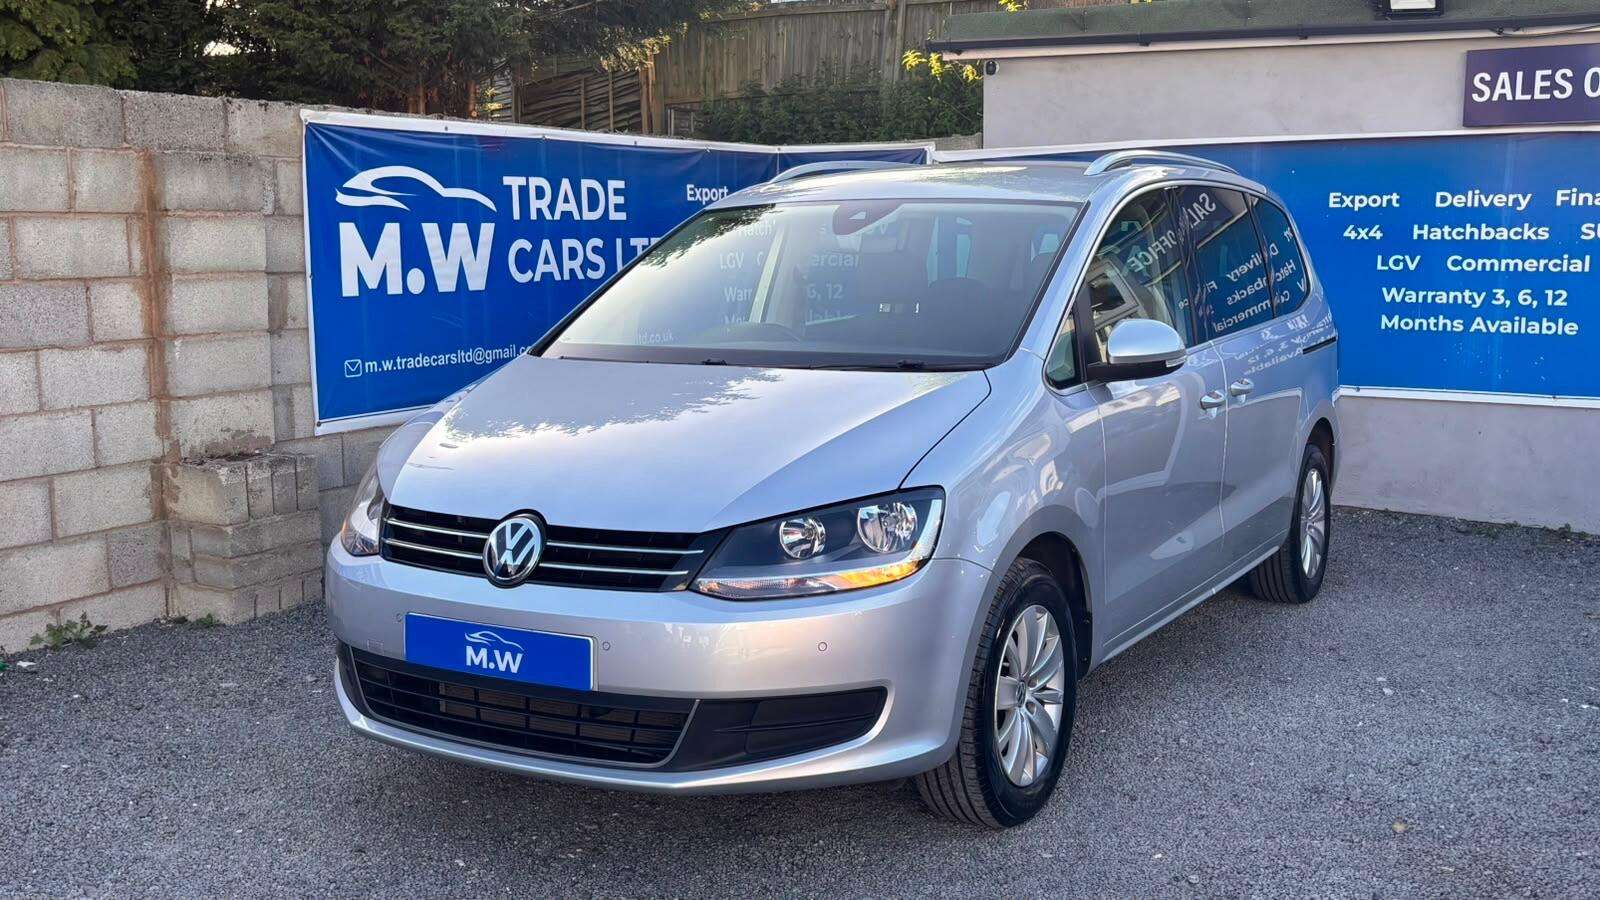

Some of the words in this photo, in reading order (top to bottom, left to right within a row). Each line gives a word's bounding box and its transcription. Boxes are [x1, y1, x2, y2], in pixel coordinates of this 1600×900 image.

[1471, 68, 1574, 103] SALES
[502, 176, 627, 221] TRADE
[686, 184, 728, 205] Export
[1329, 192, 1400, 211] Export
[1435, 189, 1533, 211] Delivery
[1343, 224, 1384, 240] 4x4
[1413, 222, 1550, 240] Hatchbacks
[339, 222, 496, 297] M.W
[508, 237, 606, 283] CARS
[616, 237, 662, 273] LT
[1377, 255, 1421, 271] LGV
[1446, 254, 1590, 273] Commercial
[1382, 287, 1486, 308] Warranty
[1492, 288, 1511, 308] 3,
[1517, 289, 1538, 309] 6,
[1545, 289, 1568, 306] 12
[1381, 314, 1464, 332] Months
[1469, 316, 1579, 336] Available
[465, 645, 524, 674] M.W
